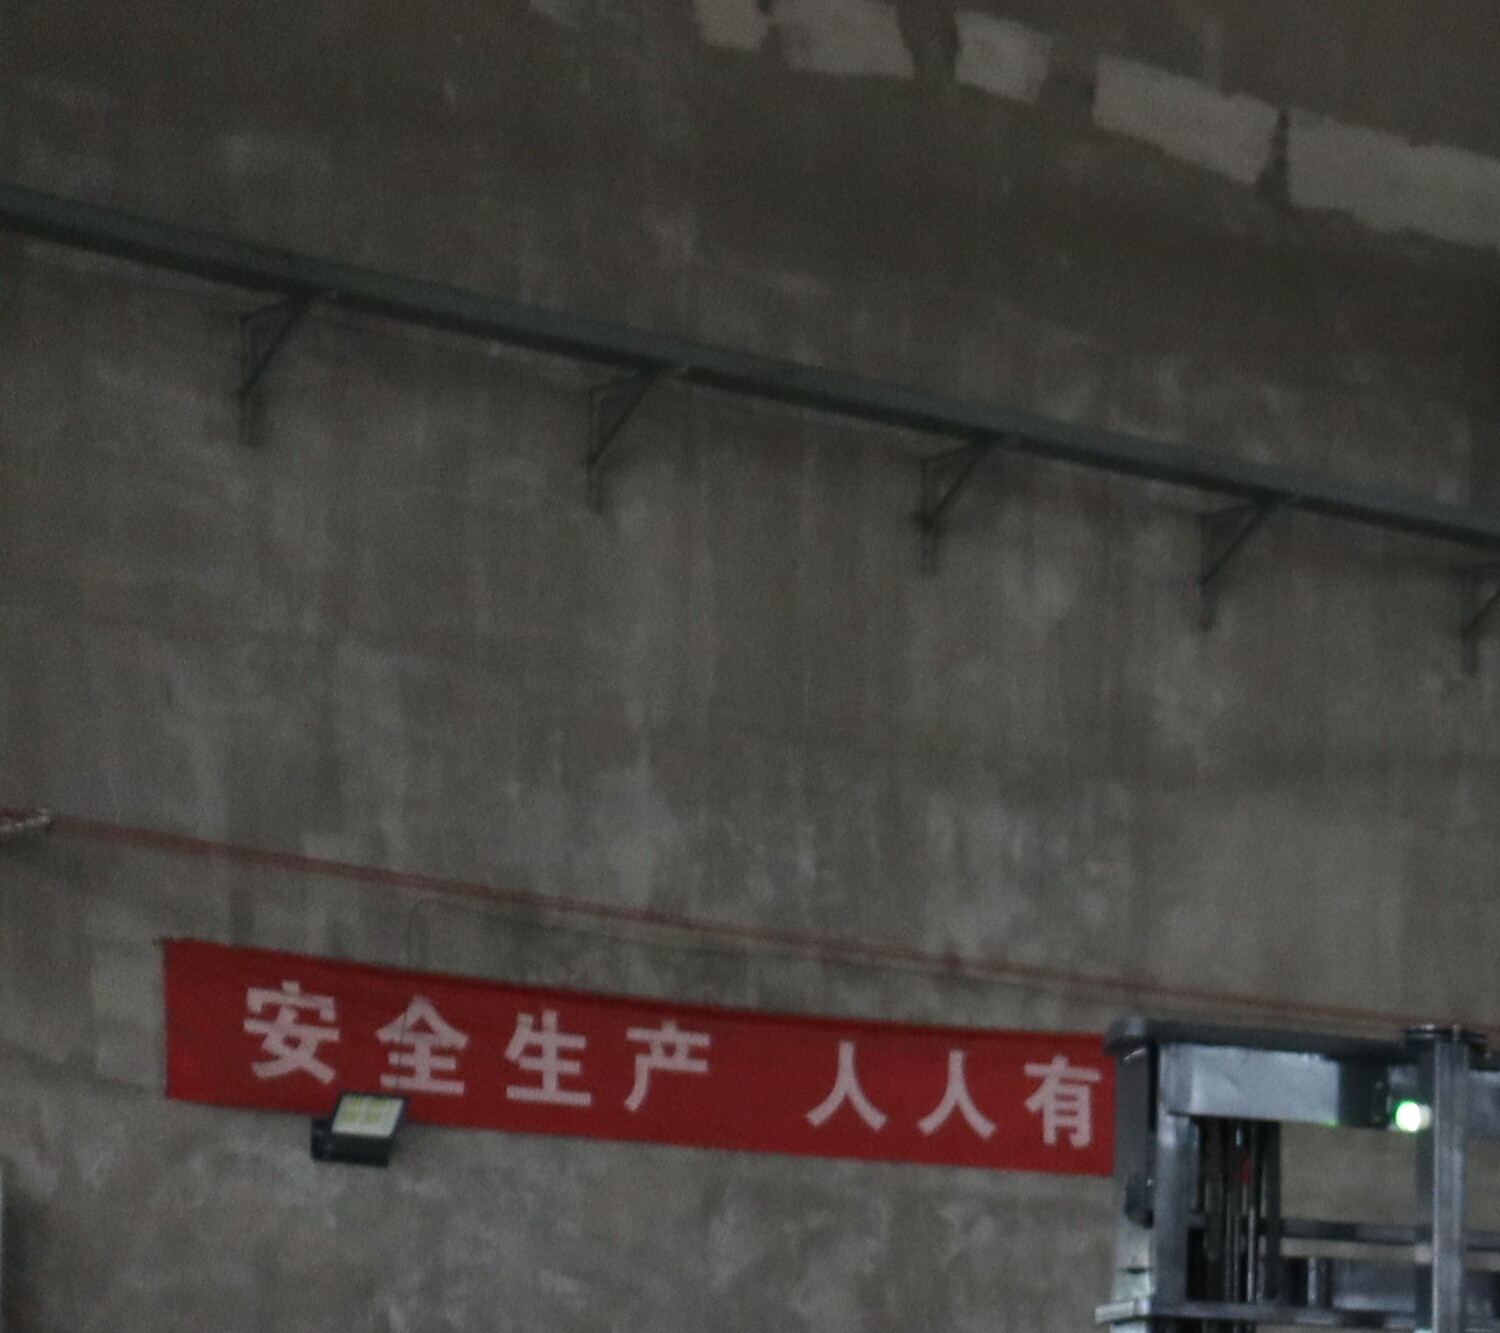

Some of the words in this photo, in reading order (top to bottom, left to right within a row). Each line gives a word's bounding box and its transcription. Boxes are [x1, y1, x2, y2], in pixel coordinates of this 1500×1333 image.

[243, 982, 711, 1112] 安全生产
[805, 1042, 1102, 1149] 人人有
